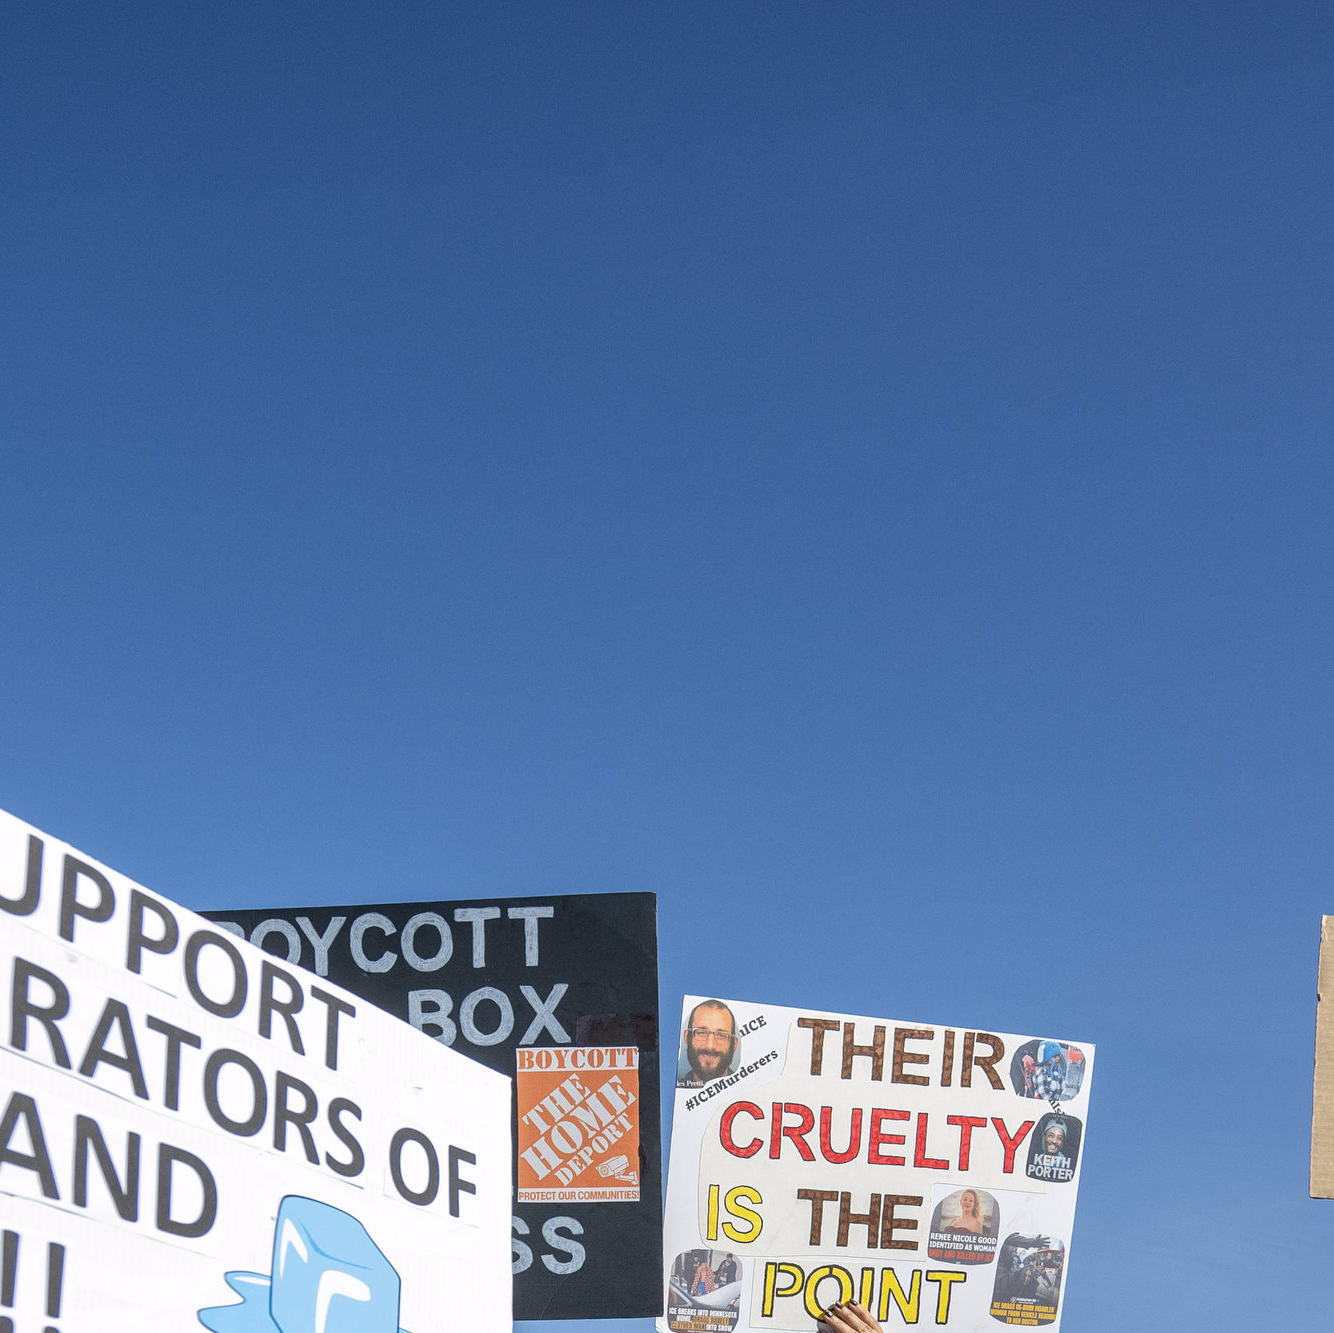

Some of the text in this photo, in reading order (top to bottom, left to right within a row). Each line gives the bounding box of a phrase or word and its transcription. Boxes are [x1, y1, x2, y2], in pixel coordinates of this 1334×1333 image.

[224, 906, 555, 977] OYCOTT
[409, 983, 572, 1047] BOX
[518, 1048, 639, 1069] BOYCOTT
[685, 1050, 778, 1111] #ICEMurderers
[797, 1017, 1006, 1090] THEIR
[520, 1075, 637, 1180] HOME
[521, 1073, 591, 1135] THE
[554, 1112, 634, 1187] DEPORT
[719, 1100, 1035, 1174] CRUELTY
[1033, 1153, 1071, 1169] KEITH
[389, 1127, 478, 1218] OF
[519, 1190, 639, 1201] PROTECT OUR COMMUNITIES!
[1027, 1164, 1074, 1180] PORTER
[706, 1184, 923, 1250] IS THE
[929, 1240, 964, 1250] IDENTIFIED
[930, 1232, 997, 1245] RENEE NICOLE GOOD
[761, 1261, 966, 1324] POINT
